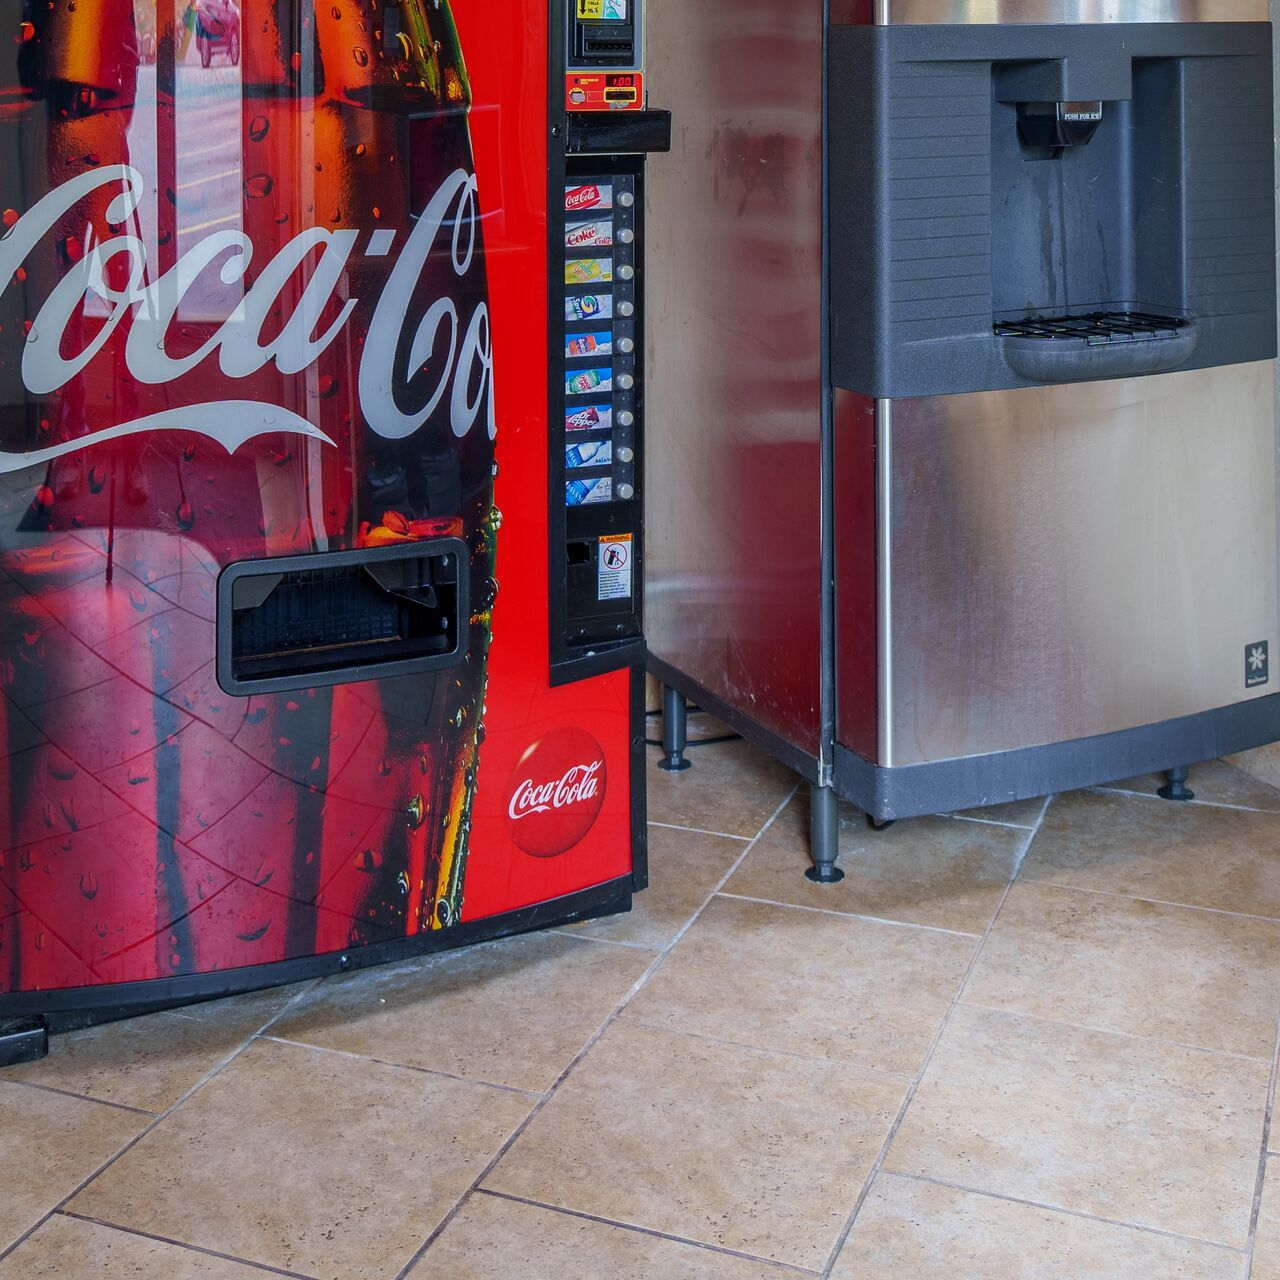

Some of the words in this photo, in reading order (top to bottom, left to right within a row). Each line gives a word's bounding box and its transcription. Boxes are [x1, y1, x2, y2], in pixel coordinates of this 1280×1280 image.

[613, 77, 631, 86] 1.00
[565, 187, 595, 208] Coca-Cola
[567, 229, 595, 245] Coke
[594, 237, 611, 245] Coke
[572, 298, 583, 319] Sprite
[567, 413, 597, 427] Pepper
[579, 411, 591, 420] Dr
[605, 534, 630, 542] WARNING
[508, 760, 603, 819] Coca-Cola
